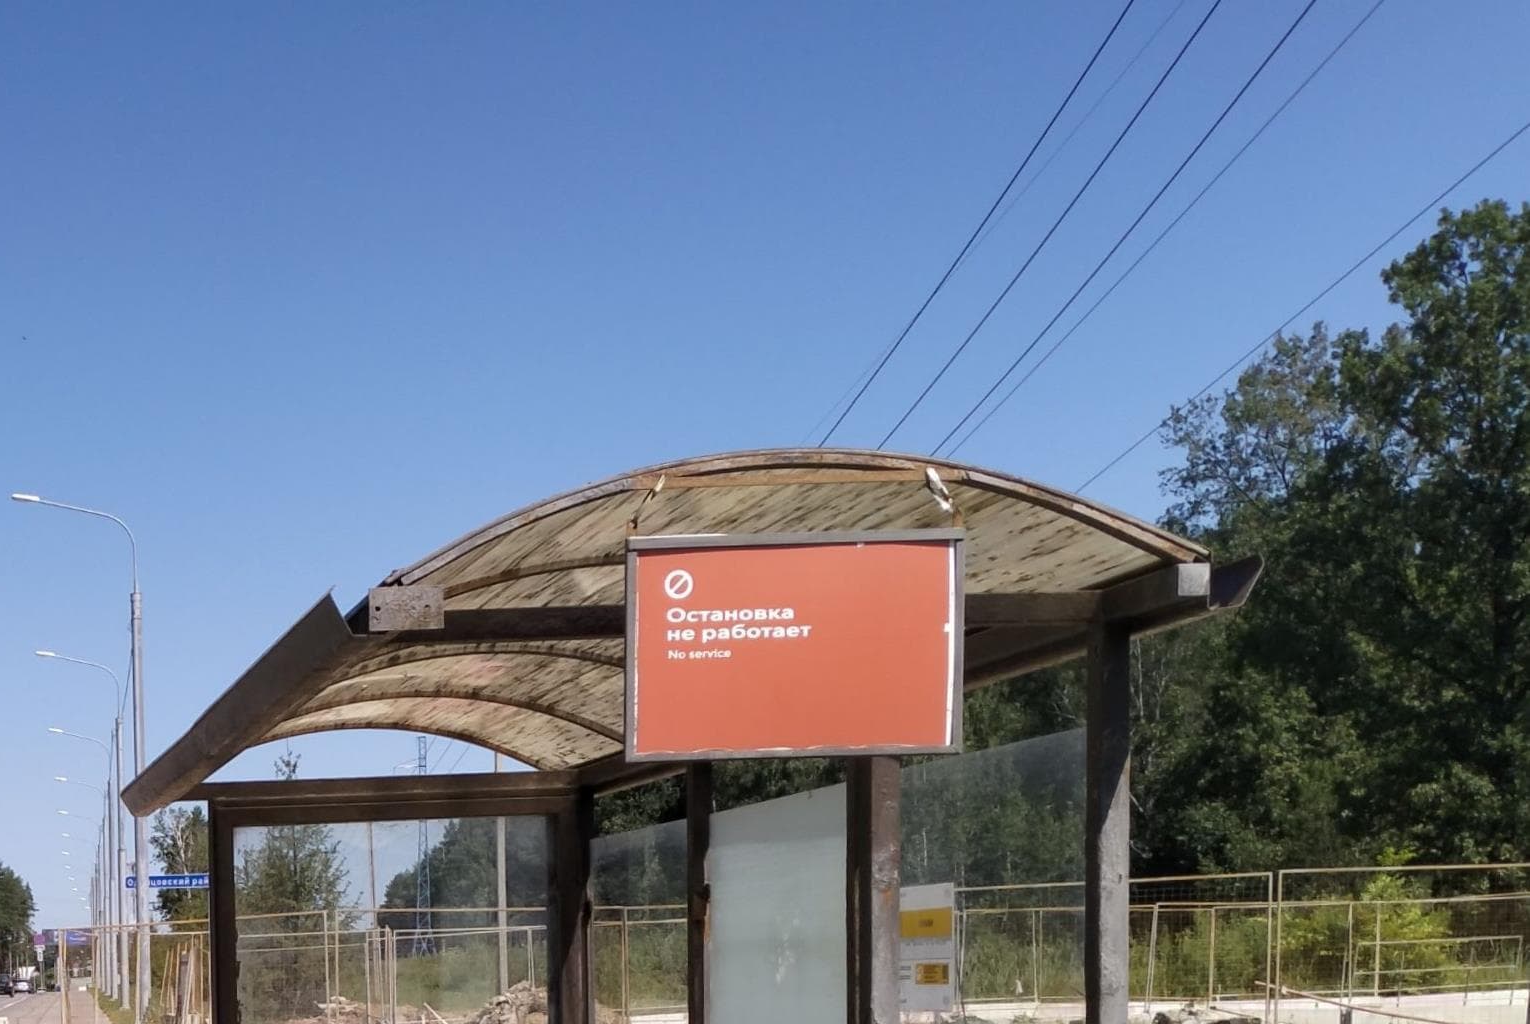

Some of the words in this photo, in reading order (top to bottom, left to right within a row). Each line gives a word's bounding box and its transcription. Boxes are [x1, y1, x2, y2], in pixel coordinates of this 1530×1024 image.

[666, 607, 795, 623] Остановка
[667, 628, 696, 642] не
[702, 624, 812, 644] работает
[668, 650, 687, 660] No
[689, 649, 732, 660] service
[126, 876, 190, 887] Оцовский
